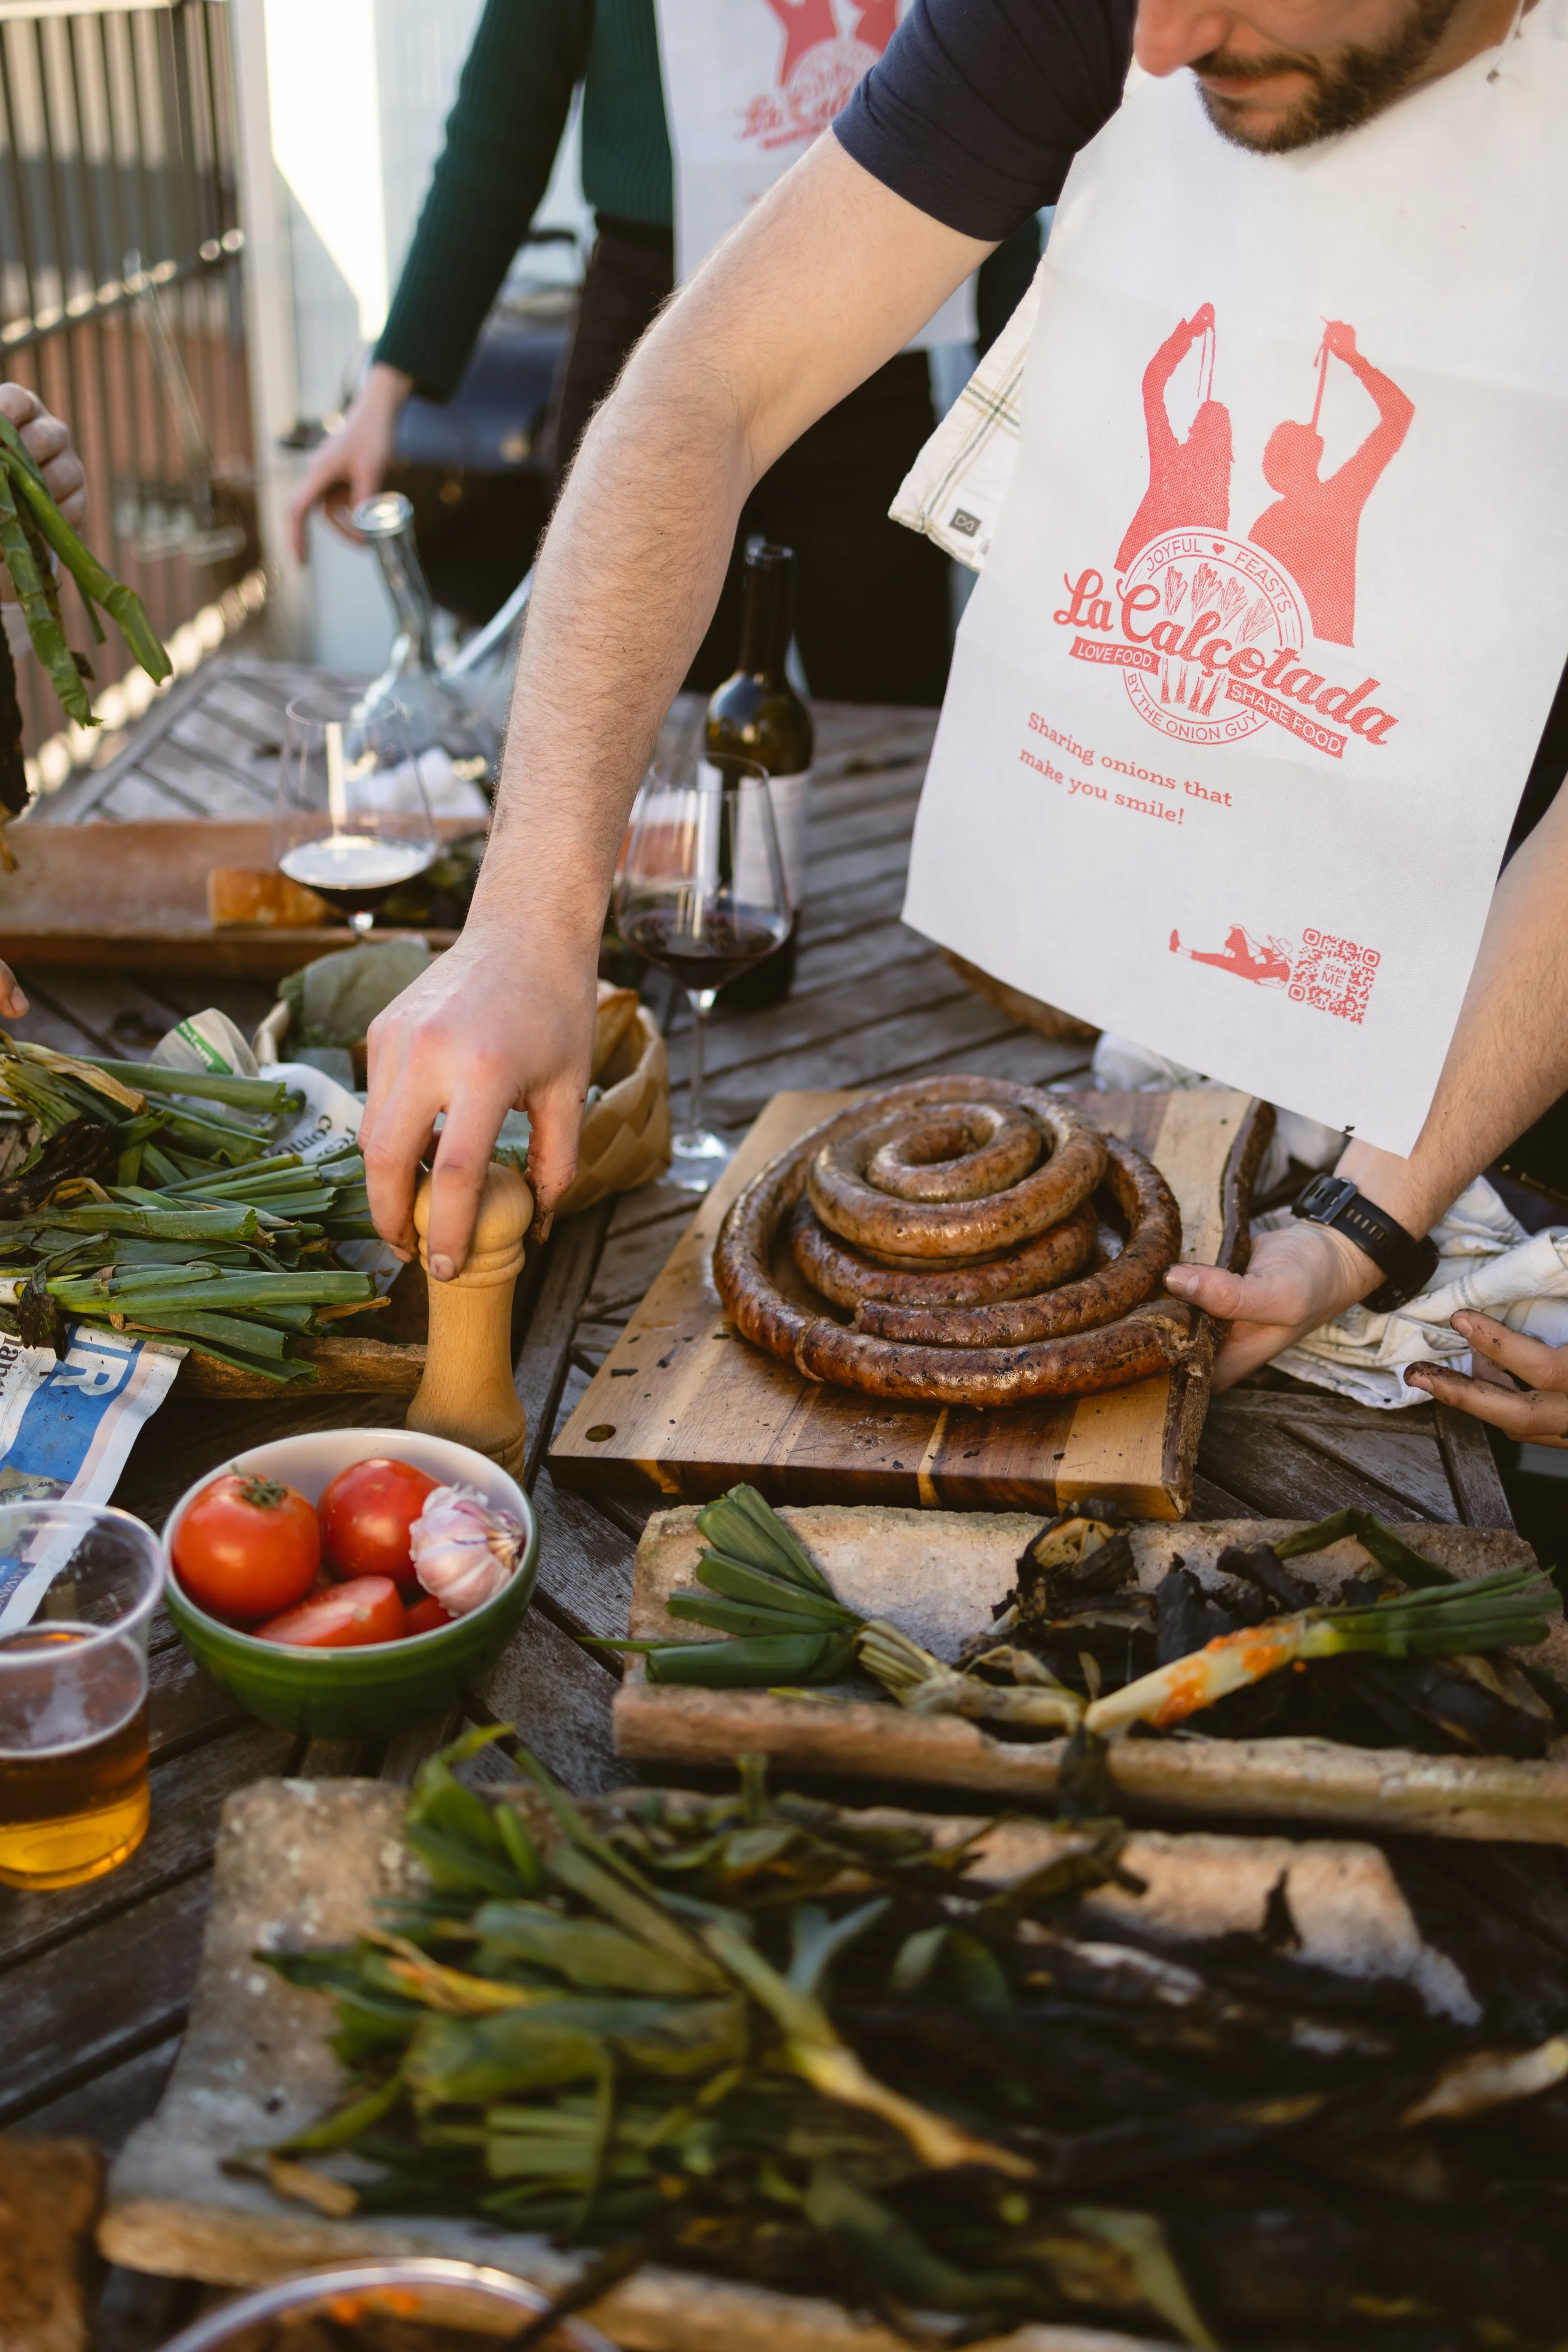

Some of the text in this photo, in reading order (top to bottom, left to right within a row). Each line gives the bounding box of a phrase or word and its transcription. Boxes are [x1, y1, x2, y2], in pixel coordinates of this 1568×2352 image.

[1146, 539, 1292, 613] JOYFUL FEASTS
[1053, 568, 1399, 745] La Calçotada
[1077, 642, 1152, 667] LOVE FOOD
[1127, 673, 1257, 740] BY THE ONION GUY
[1231, 684, 1341, 752] SHARE FOOD
[1020, 749, 1185, 824] make you smile!
[1029, 712, 1232, 807] Sharing onions that
[1322, 963, 1347, 988] SCAN ME
